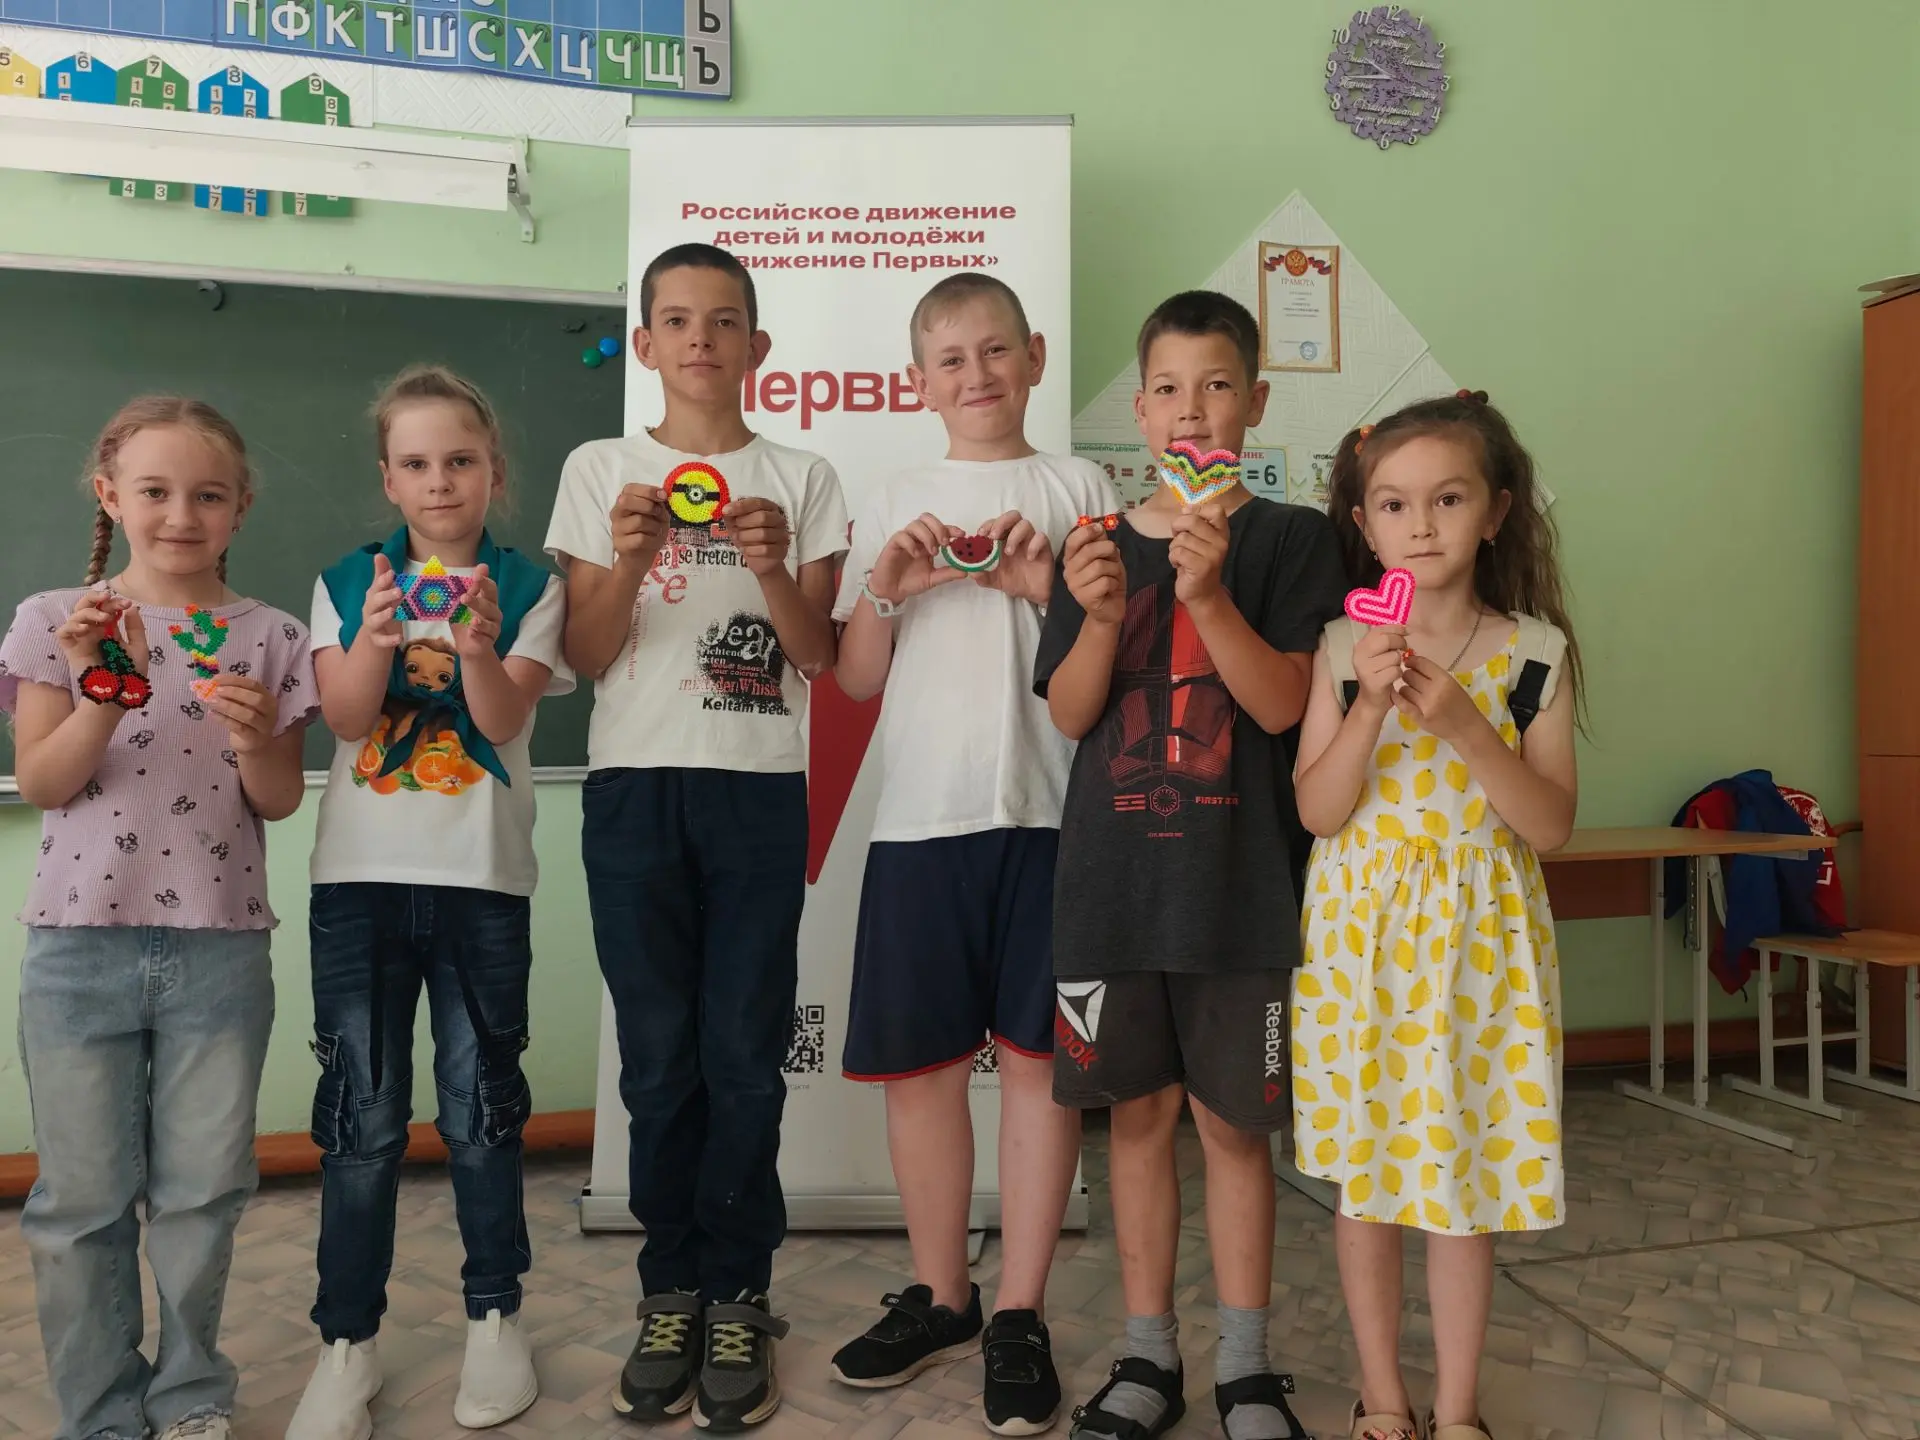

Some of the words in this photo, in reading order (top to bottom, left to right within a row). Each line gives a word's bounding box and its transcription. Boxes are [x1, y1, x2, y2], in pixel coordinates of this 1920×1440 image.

[1386, 5, 1401, 22] 12
[271, 0, 310, 40] Ф
[326, 4, 356, 48] К
[376, 11, 403, 53] Т
[417, 15, 456, 58] Ш
[468, 20, 497, 63] С
[512, 27, 545, 70] Х
[560, 33, 592, 81] Ц
[605, 38, 632, 80] Ч
[644, 41, 685, 89] Щ
[692, 46, 721, 85] Ъ
[1332, 27, 1350, 44] 10
[681, 203, 860, 221] Российское
[865, 206, 1017, 223] движение
[713, 227, 800, 247] детей
[807, 231, 824, 244] и
[831, 226, 985, 247] молодёжи
[735, 254, 866, 269] вижение
[873, 251, 999, 272] Первых»
[1264, 464, 1277, 486] 6
[1265, 1001, 1282, 1079] Reebok
